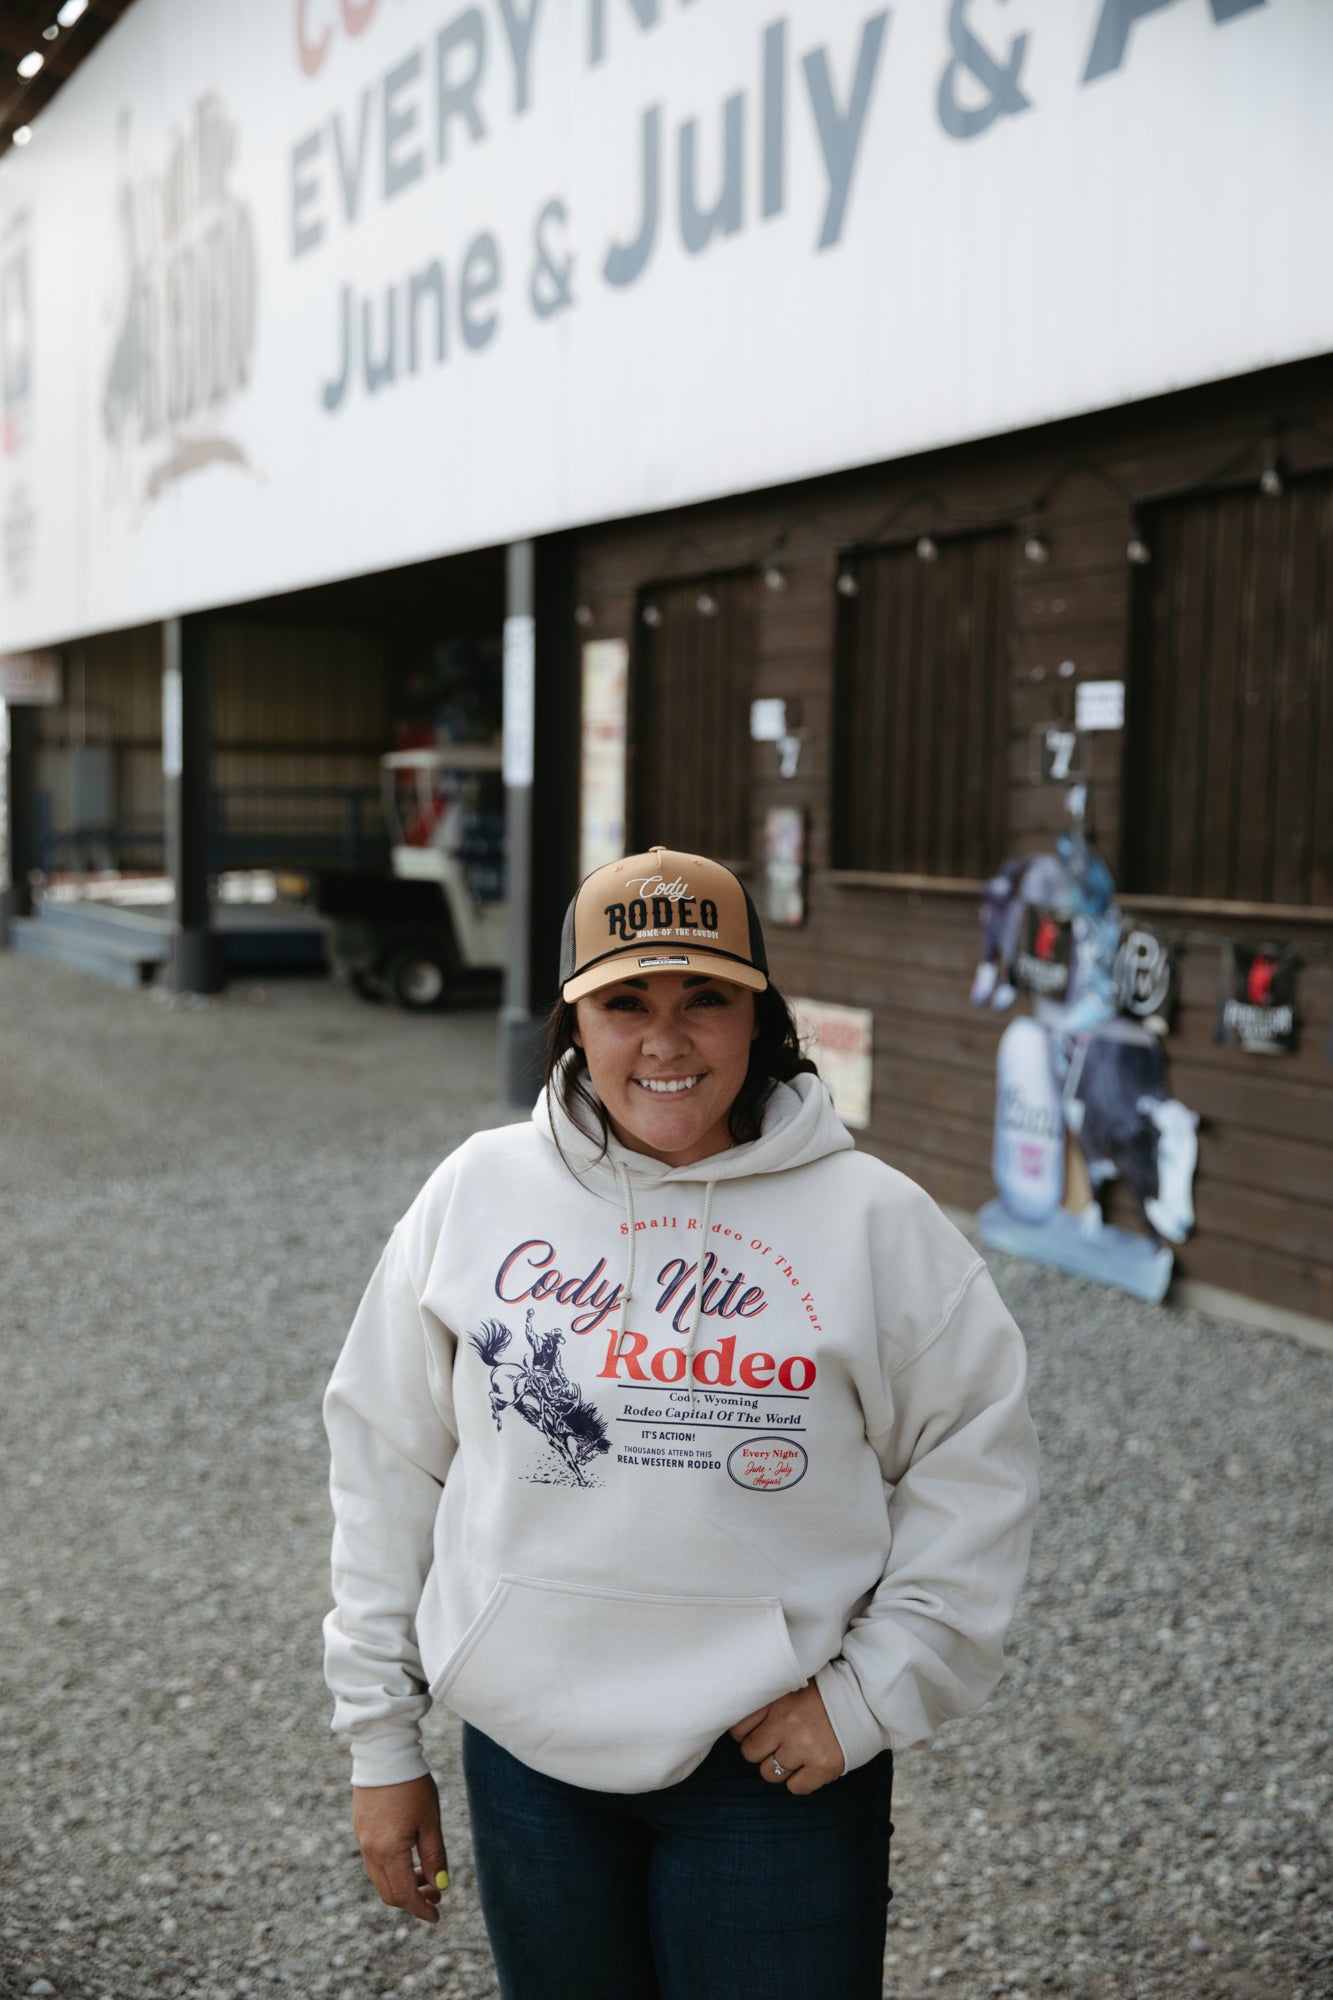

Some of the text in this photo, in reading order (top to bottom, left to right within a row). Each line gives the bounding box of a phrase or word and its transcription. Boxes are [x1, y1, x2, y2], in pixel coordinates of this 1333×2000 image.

[290, 0, 541, 260] EVERY
[320, 230, 500, 413] June
[529, 196, 575, 322] &
[601, 5, 892, 287] July
[935, 0, 1034, 140] &
[625, 875, 695, 902] Cody
[604, 897, 718, 941] RODEO
[675, 928, 690, 936] THE
[620, 1216, 823, 1332] Small Rdeo Of The Year
[494, 1239, 768, 1335] Cody Nite
[596, 1328, 816, 1391] Rodeo
[704, 1395, 759, 1409] Wyoming
[623, 1405, 801, 1425] Rodeo Capital Of The World
[641, 1430, 696, 1442] IT'S ACTION!
[624, 1446, 712, 1458] THOUSANDS ATTEND THIS
[742, 1449, 799, 1460] Every Night
[617, 1455, 721, 1470] REAL WESTERN RODEO
[744, 1461, 793, 1477] June July
[753, 1474, 782, 1488] August
